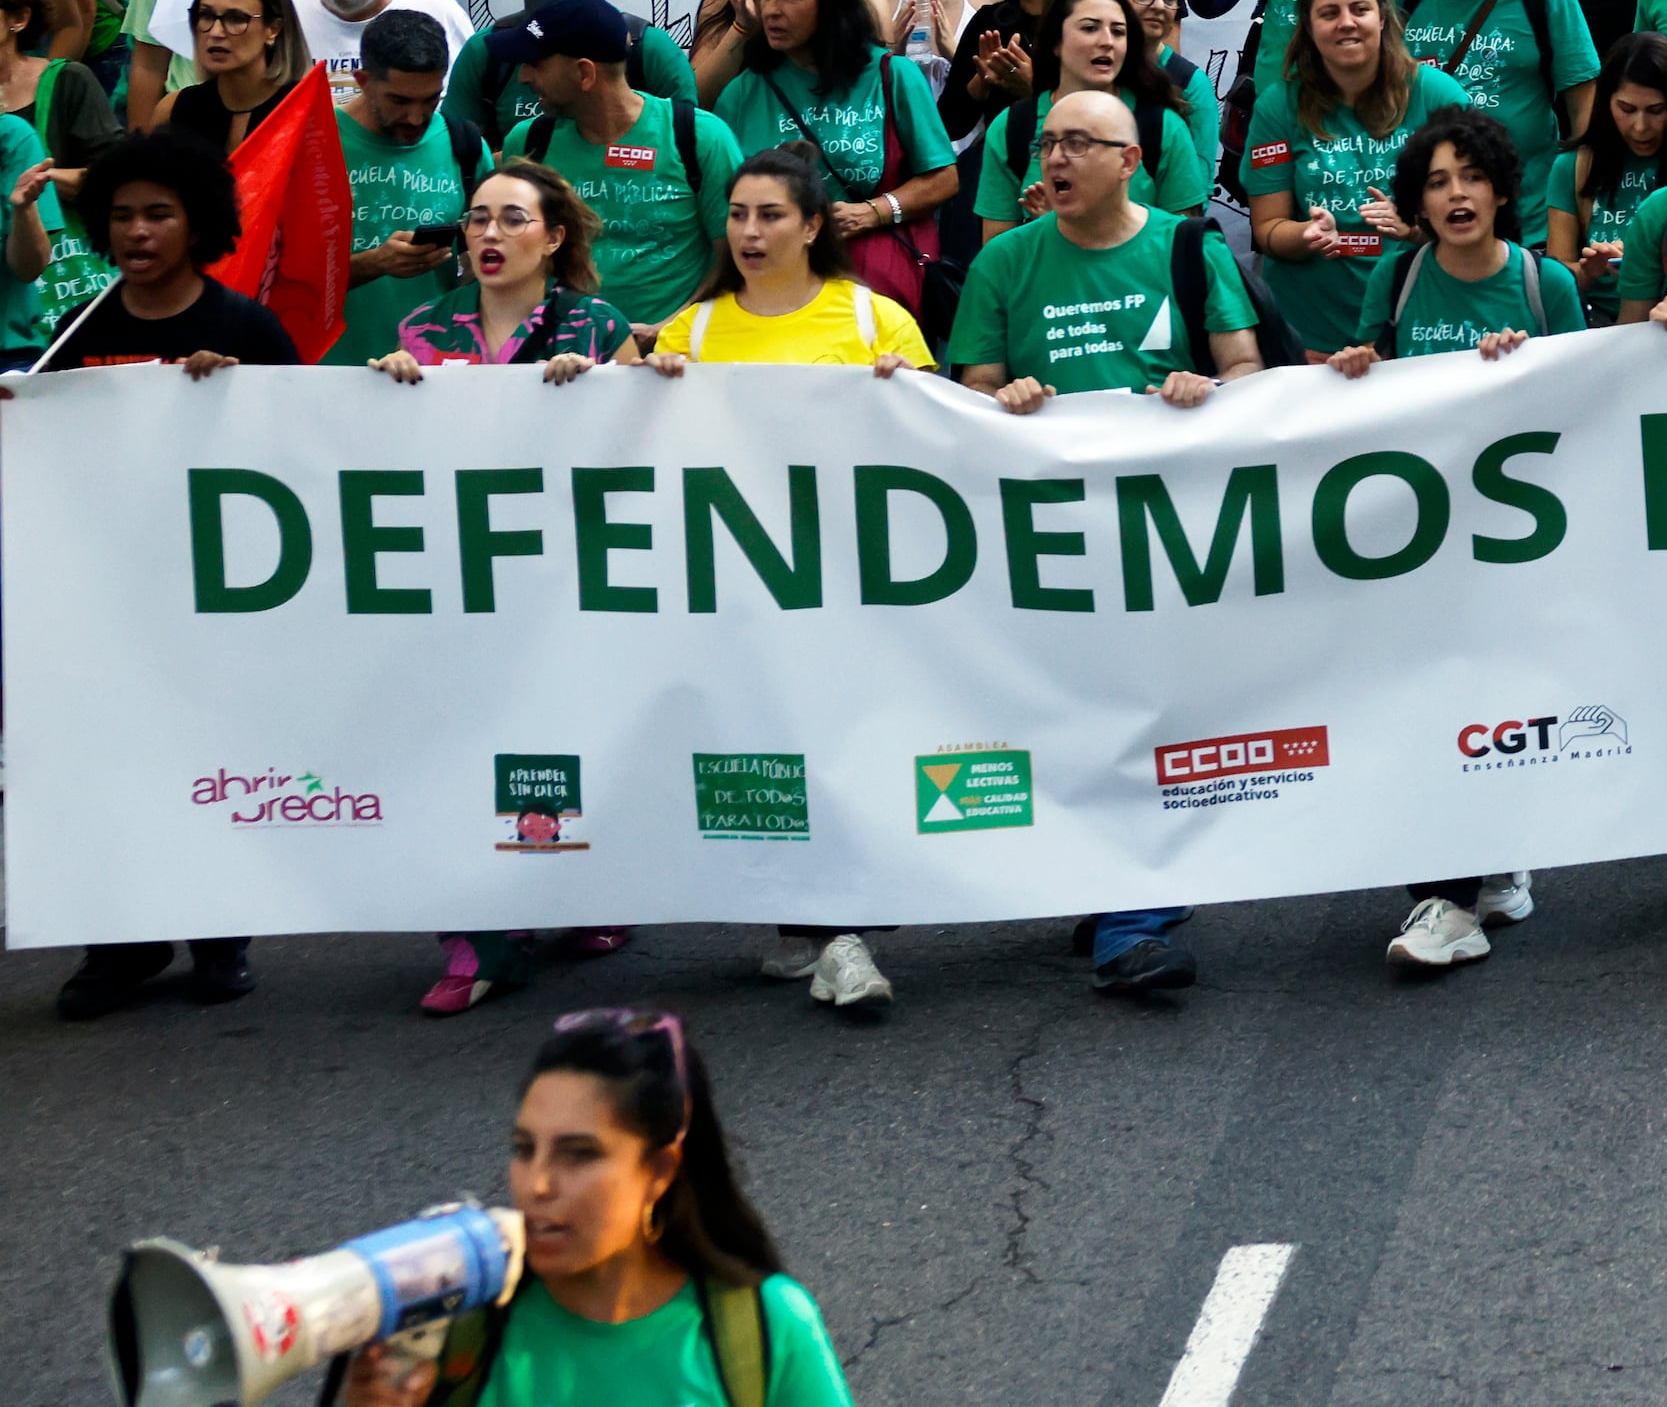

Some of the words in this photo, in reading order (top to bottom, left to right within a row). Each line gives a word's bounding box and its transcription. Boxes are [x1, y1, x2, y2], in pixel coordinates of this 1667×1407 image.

[607, 145, 655, 160] CCOO
[1041, 296, 1120, 321] Queremos
[1123, 293, 1146, 310] FP
[1046, 324, 1064, 343] de
[1067, 321, 1108, 340] todas
[1048, 343, 1082, 363] para
[1083, 337, 1124, 356] todas
[188, 431, 1567, 614] DEFENDEMOS
[937, 741, 1009, 753] ASAMBLEA
[1457, 716, 1558, 758] CGT
[970, 762, 1013, 774] MENOS
[1164, 739, 1274, 777] CCOO
[1463, 754, 1560, 772] Enseñanza
[1570, 746, 1633, 760] Madrid
[509, 768, 568, 784] APRENDER
[966, 774, 1020, 788] LECTIVAS
[1162, 780, 1236, 797] educación
[1238, 776, 1248, 790] y
[1249, 769, 1314, 786] servicios
[509, 782, 532, 796] SIN
[534, 783, 569, 798] CALOR
[1163, 788, 1279, 810] socioeducativos
[966, 805, 1022, 817] EDUCATIVA
